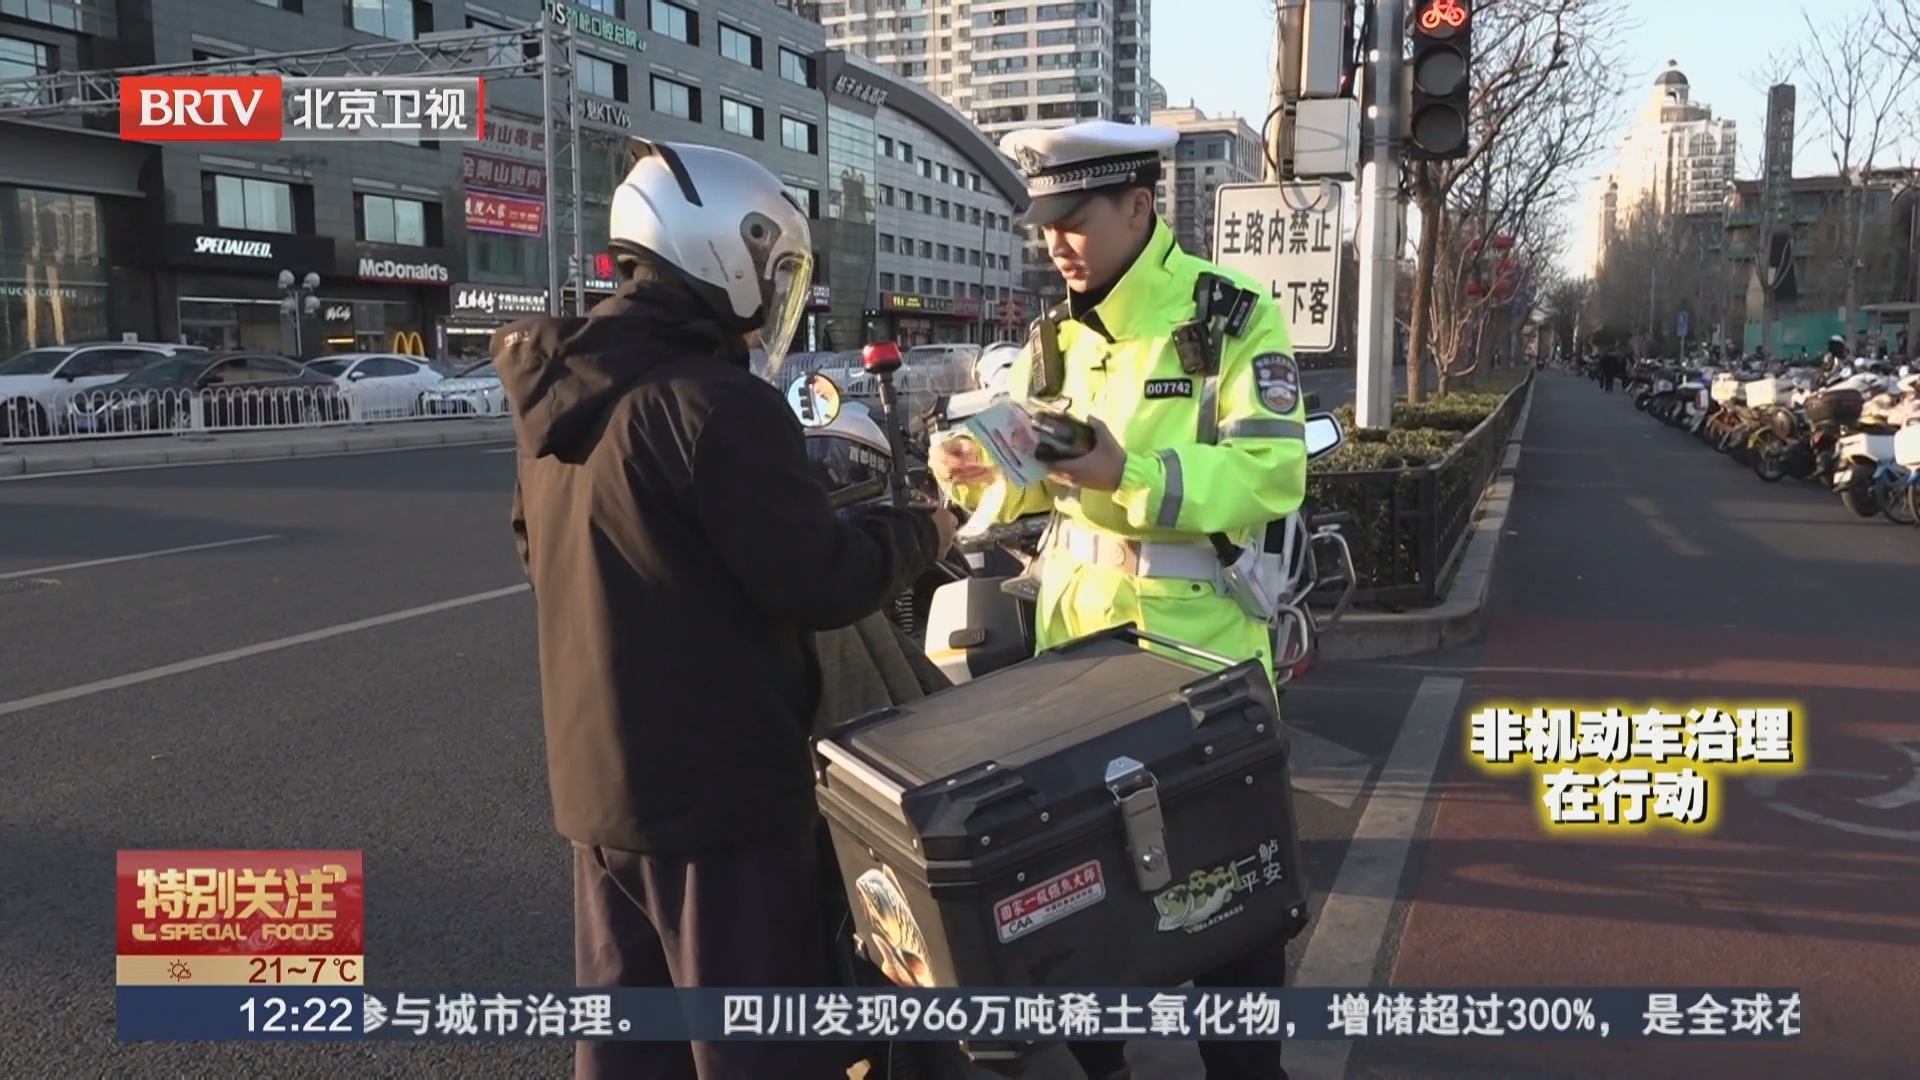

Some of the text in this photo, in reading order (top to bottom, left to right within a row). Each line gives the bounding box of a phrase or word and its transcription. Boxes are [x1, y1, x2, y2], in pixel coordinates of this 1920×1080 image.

[1222, 208, 1332, 256] 主路内禁止
[359, 258, 448, 281] McDonald's
